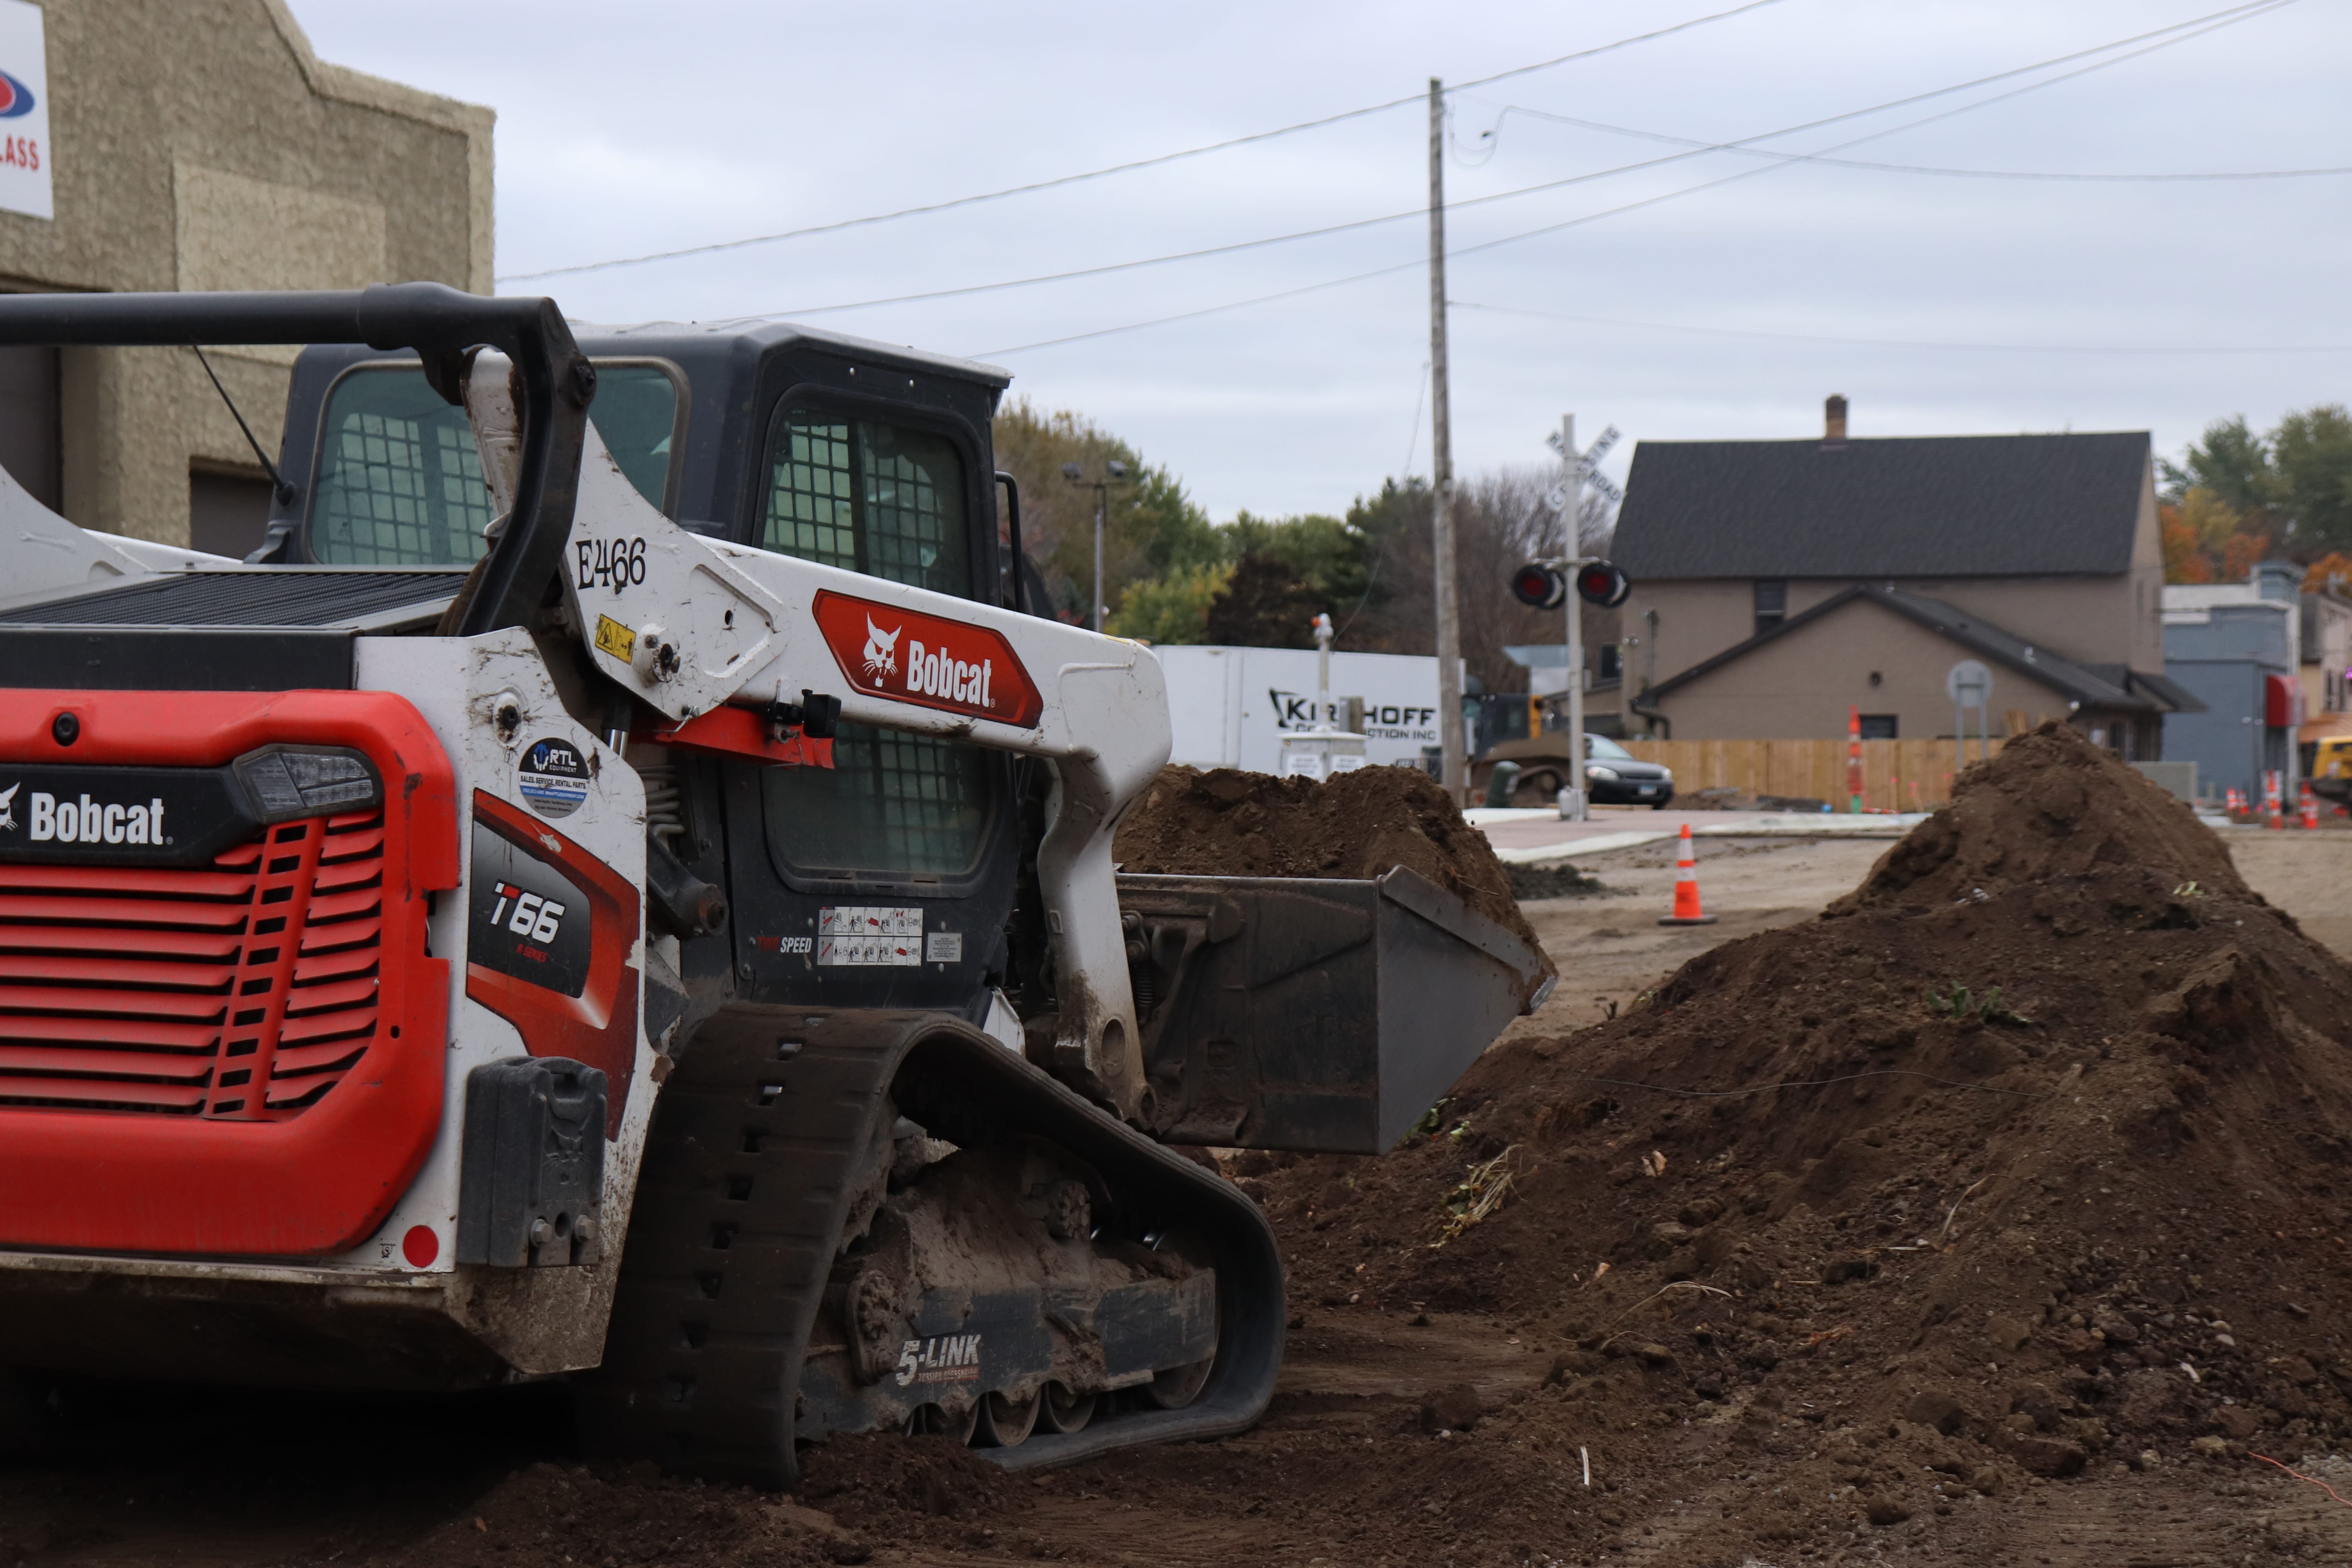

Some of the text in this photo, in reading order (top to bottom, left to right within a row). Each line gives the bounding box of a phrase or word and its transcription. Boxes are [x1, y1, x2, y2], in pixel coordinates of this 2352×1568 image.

[0, 134, 39, 171] ASS
[576, 537, 646, 590] E466
[1288, 698, 1436, 725] KIRHOFF
[1414, 729, 1436, 740] INC
[550, 749, 577, 766] RTL
[516, 943, 548, 963] R-SERIES
[780, 936, 812, 953] SPEED
[896, 1334, 982, 1386] 5-LINK
